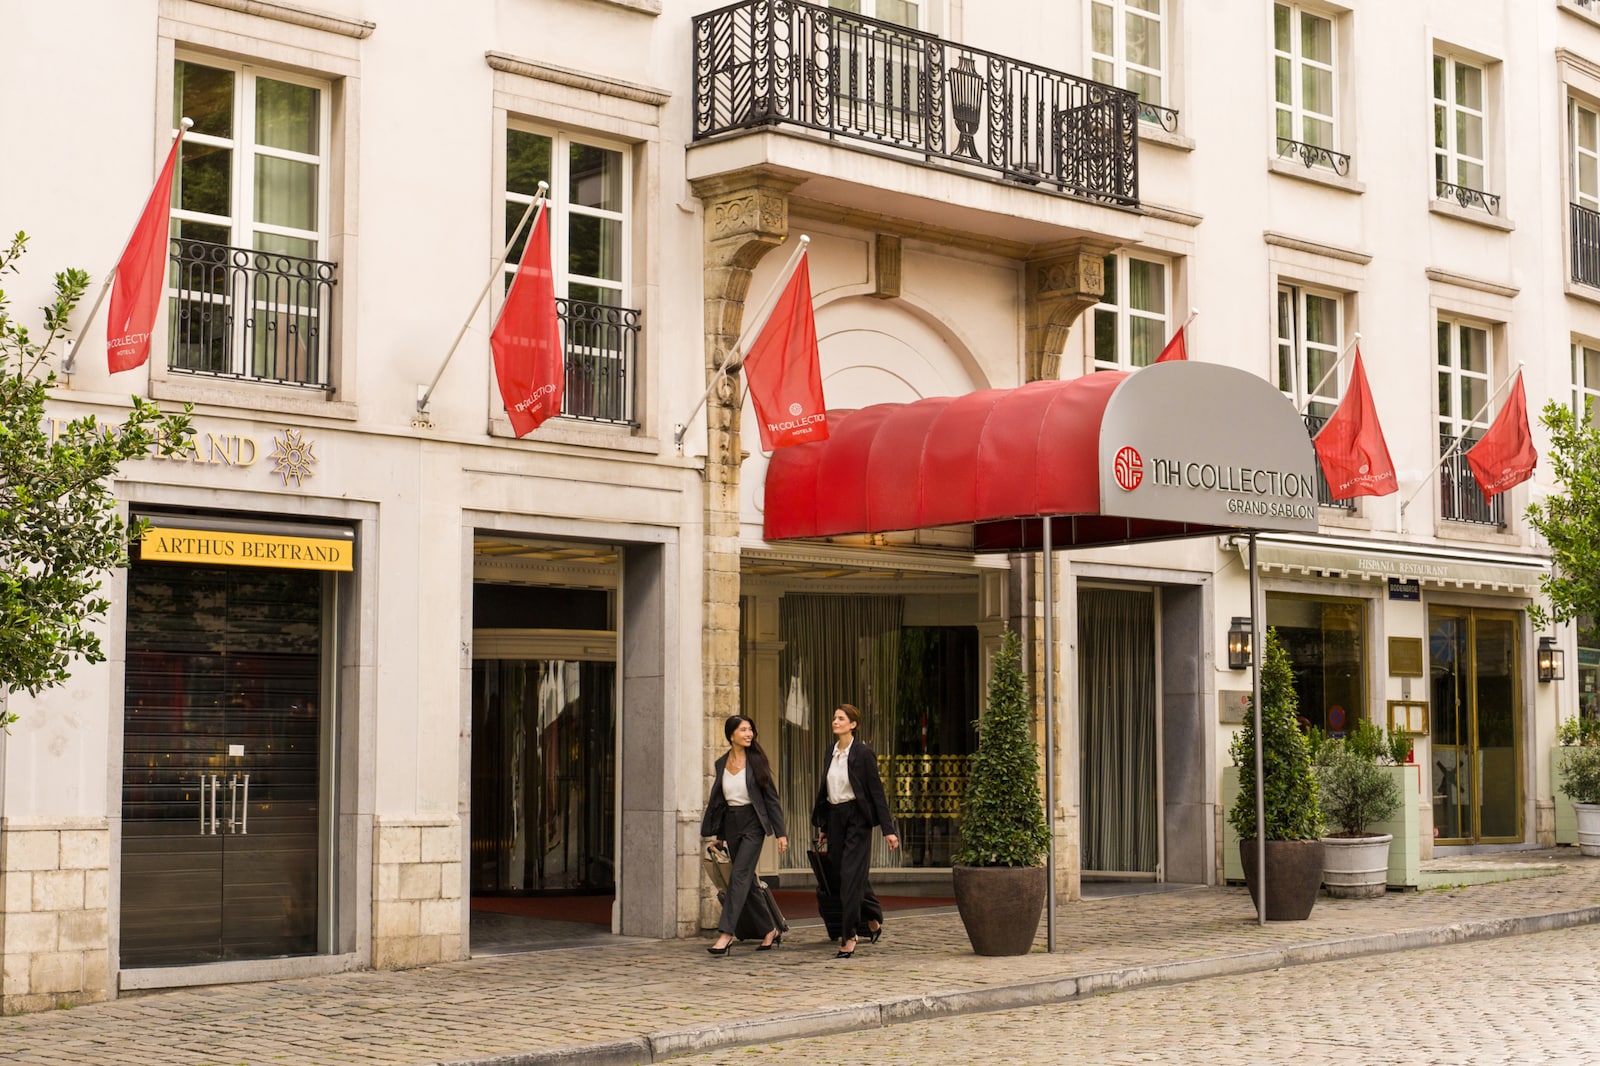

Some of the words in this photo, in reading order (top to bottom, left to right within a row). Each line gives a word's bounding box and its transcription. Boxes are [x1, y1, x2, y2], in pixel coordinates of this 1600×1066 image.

[1185, 462, 1313, 498] COLLECTION
[1227, 499, 1268, 515] GRAND
[1269, 502, 1315, 520] SABLON
[155, 537, 234, 556] ARTHUS
[241, 541, 340, 563] BERTRAND
[1359, 559, 1395, 572] HISPANIA
[1399, 562, 1449, 576] RESTAURANT
